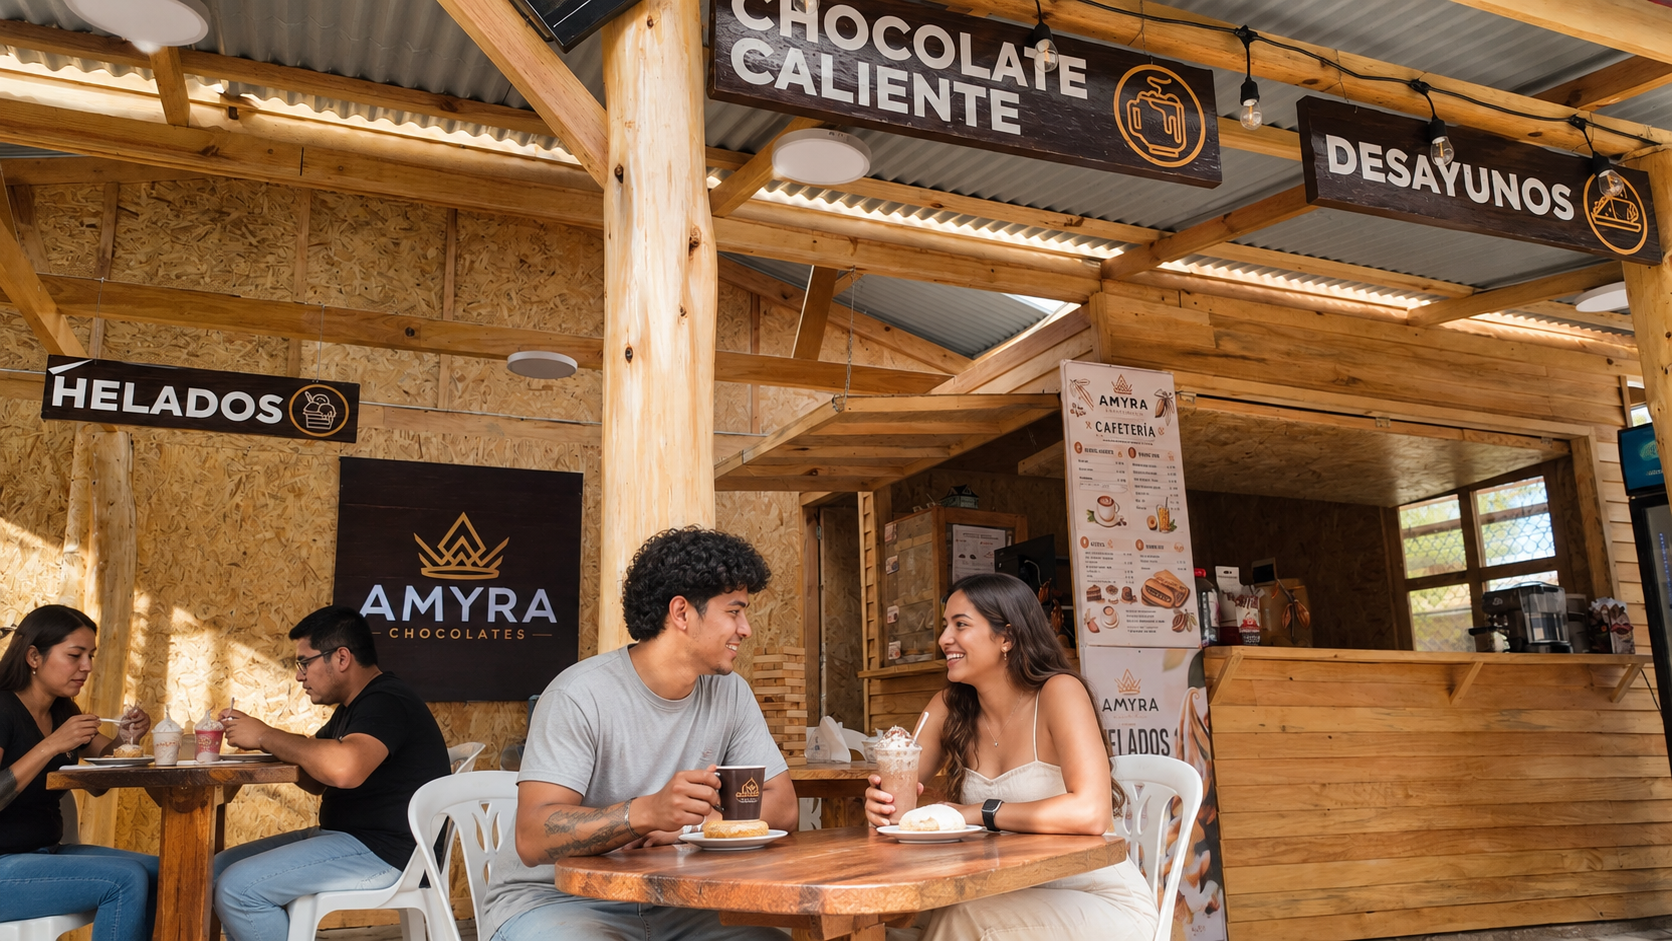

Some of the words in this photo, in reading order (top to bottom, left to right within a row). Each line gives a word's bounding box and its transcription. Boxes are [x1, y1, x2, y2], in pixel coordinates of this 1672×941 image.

[731, 0, 1088, 100] CHOCOLATE
[730, 37, 1021, 136] CALIENTE
[1325, 134, 1575, 221] DESAYUNOS
[51, 375, 284, 424] HELADOS
[1099, 395, 1148, 410] AMYRA
[1095, 421, 1156, 438] CAFETERÍA
[359, 584, 558, 624] AMYRA
[389, 627, 526, 640] CHOCOLATES
[1102, 697, 1160, 712] AMYRA
[1104, 728, 1171, 756] ELADOS
